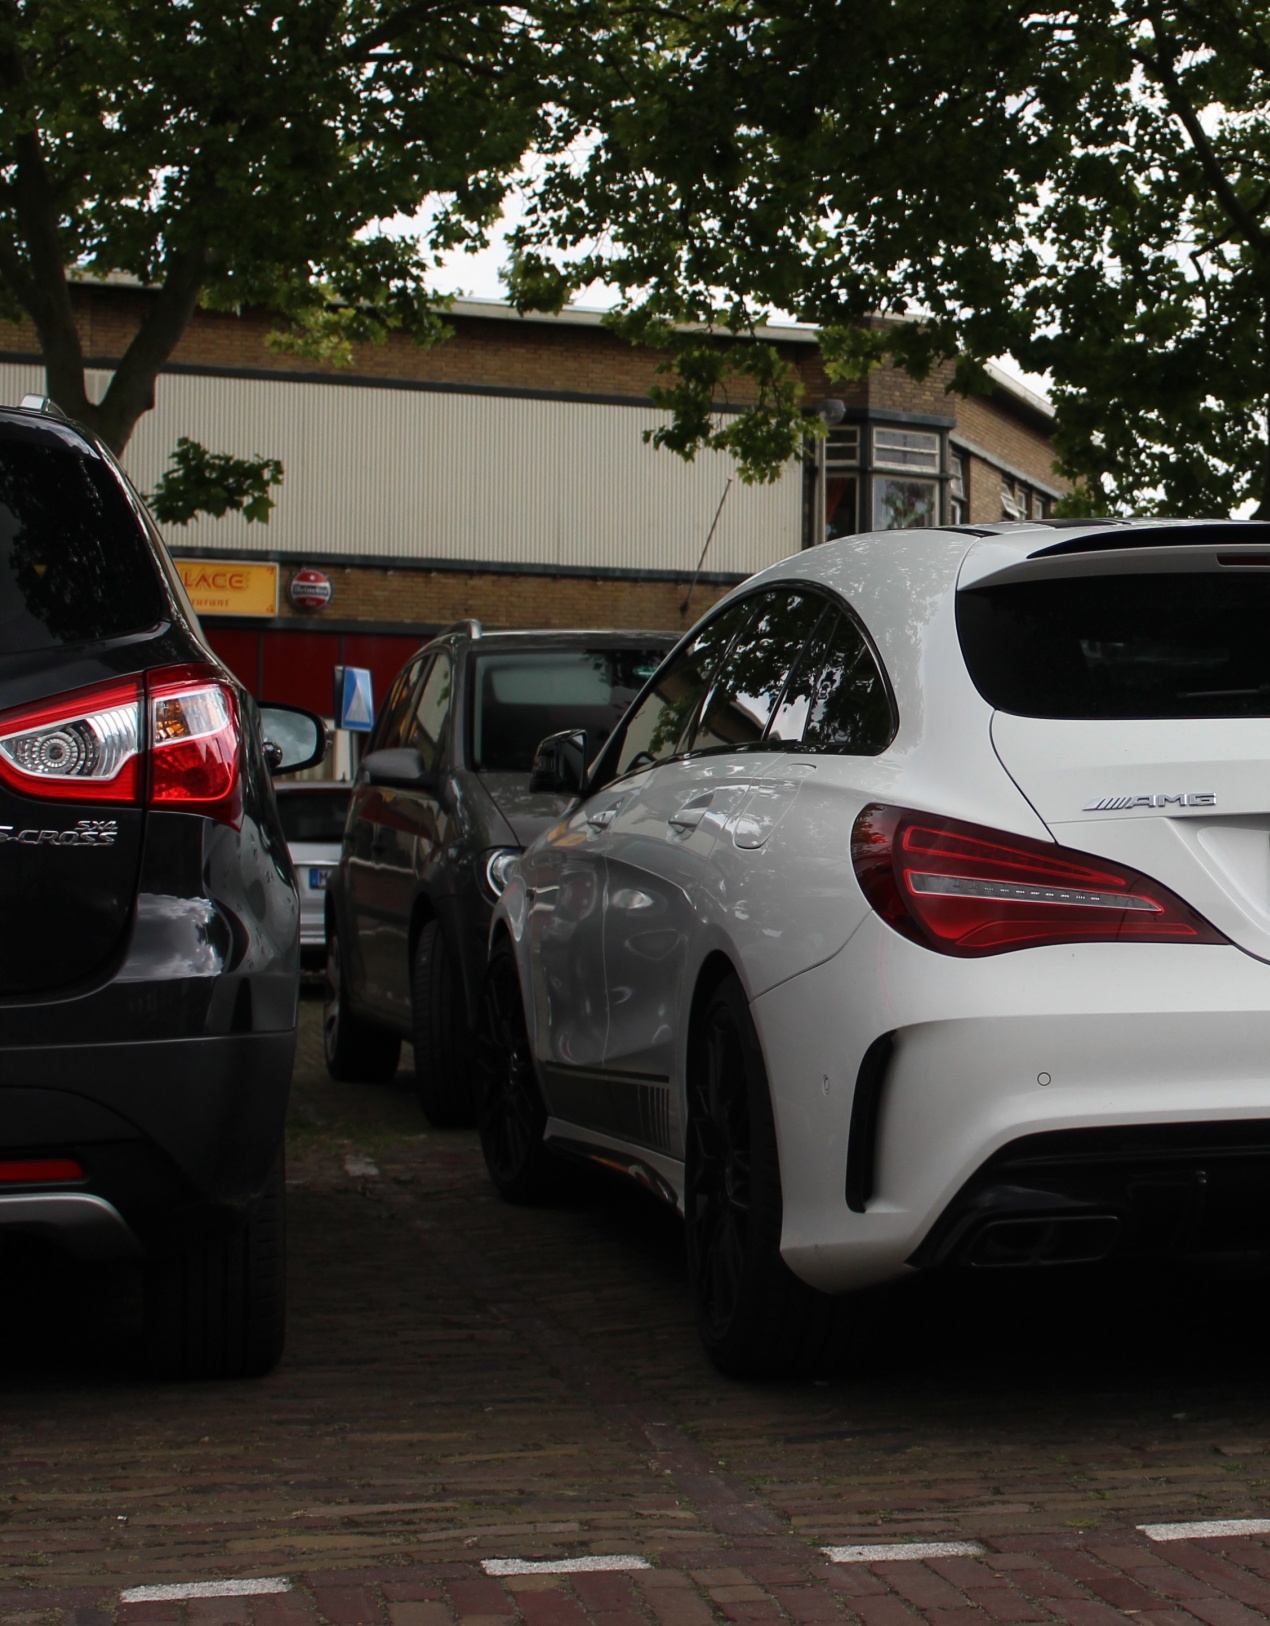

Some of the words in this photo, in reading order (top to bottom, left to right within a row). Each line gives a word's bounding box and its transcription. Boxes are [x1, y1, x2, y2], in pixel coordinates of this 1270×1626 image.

[184, 571, 244, 590] LACE
[191, 597, 230, 608] urant
[1125, 793, 1217, 809] AMG
[74, 820, 118, 831] SX4
